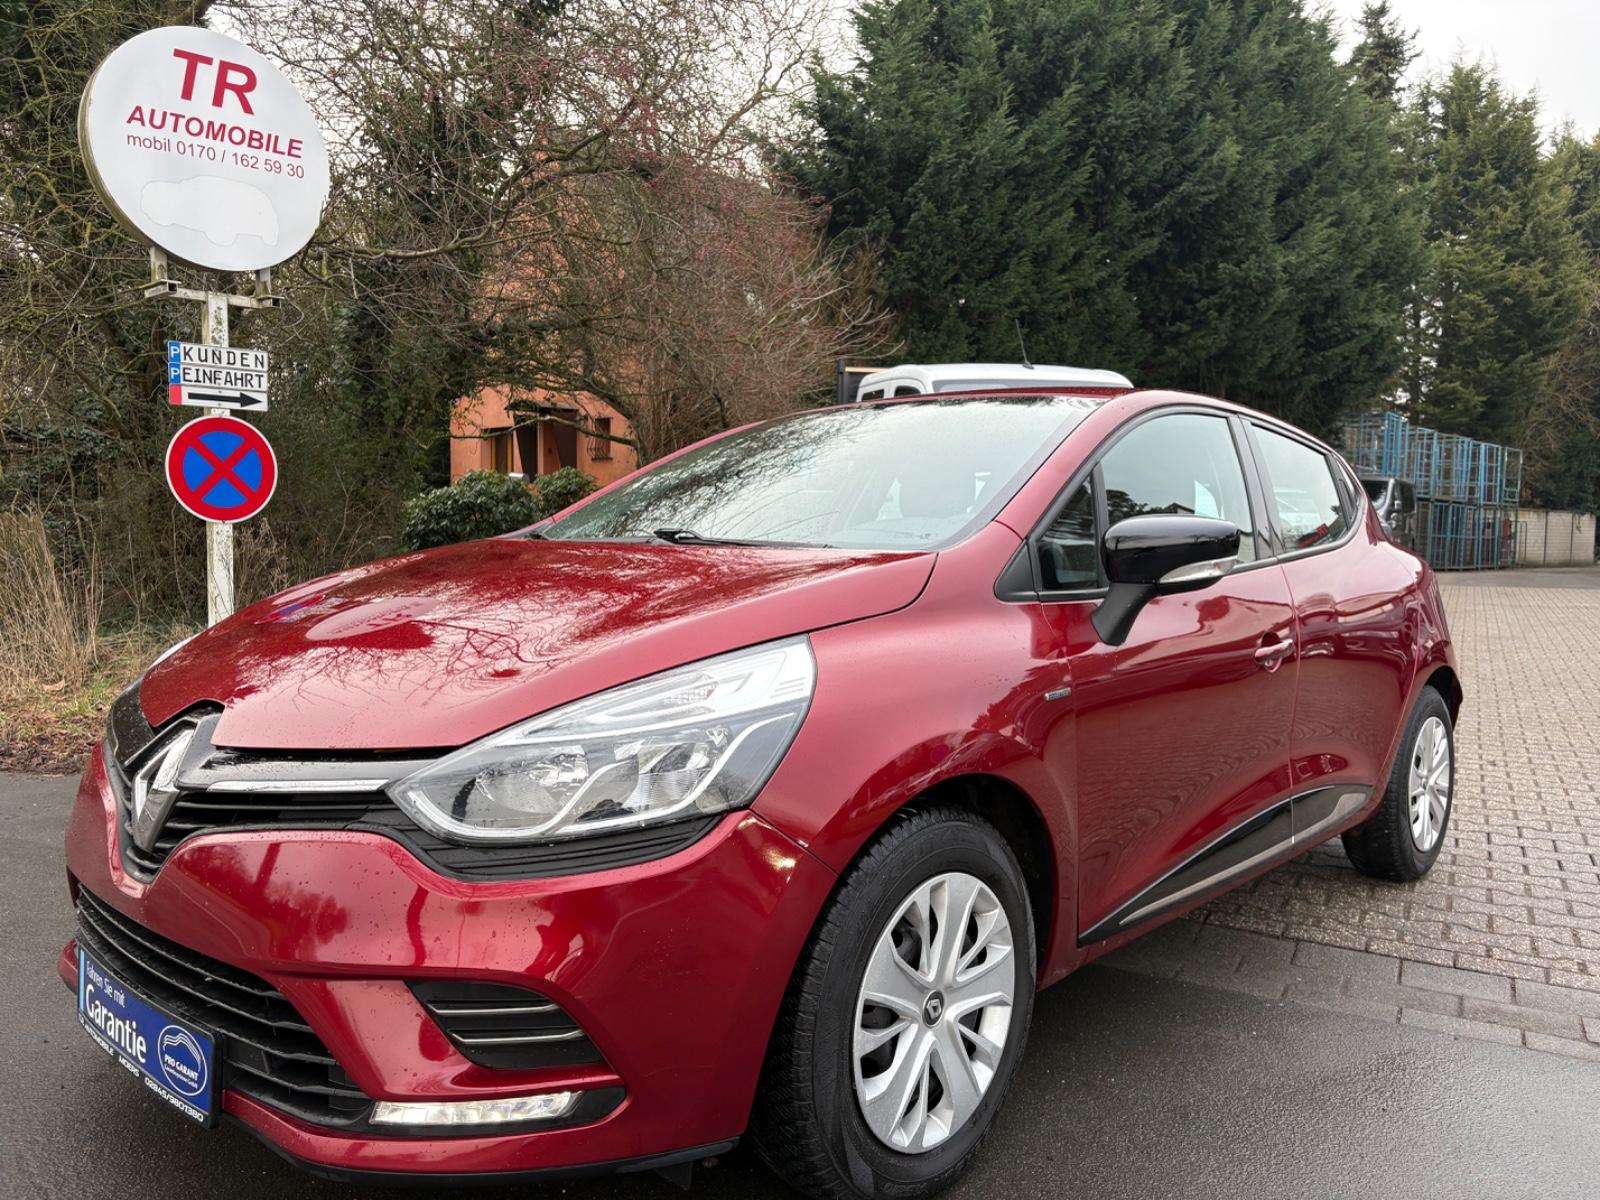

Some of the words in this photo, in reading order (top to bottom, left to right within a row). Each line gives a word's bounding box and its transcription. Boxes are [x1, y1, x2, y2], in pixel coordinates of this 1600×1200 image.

[173, 48, 257, 116] TR
[126, 105, 303, 159] AUTOMOBILE
[127, 133, 171, 152] mobil
[176, 141, 216, 161] 0170
[221, 149, 226, 163] /
[231, 152, 259, 170] 162
[264, 158, 282, 174] 59
[287, 163, 305, 179] 30
[183, 346, 265, 369] KUNDEN
[182, 367, 264, 388] EINFAHRT
[104, 978, 113, 998] Sie
[114, 990, 126, 1008] mit
[86, 984, 147, 1063] Garantie
[164, 1053, 176, 1068] PRO
[176, 1061, 199, 1081] GARANT
